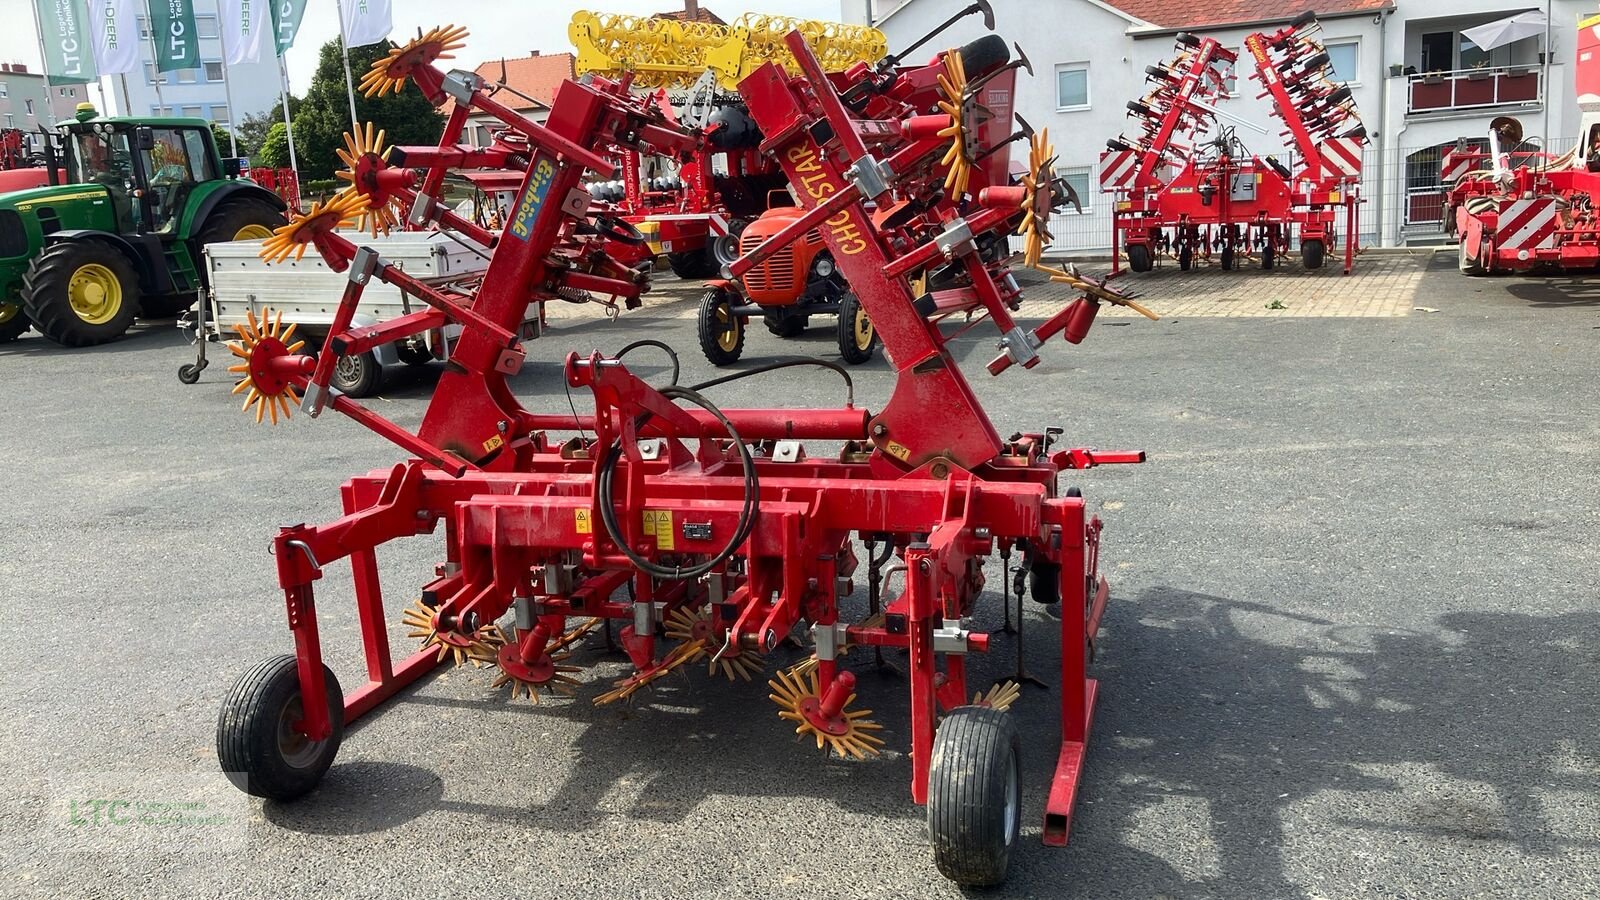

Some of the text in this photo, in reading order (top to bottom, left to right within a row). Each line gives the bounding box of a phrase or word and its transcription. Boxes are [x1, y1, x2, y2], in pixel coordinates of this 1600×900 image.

[105, 7, 118, 50] DEERE
[170, 20, 186, 60] LTC
[278, 1, 294, 44] LTC
[61, 39, 81, 75] LTC
[512, 158, 553, 238] Einböck
